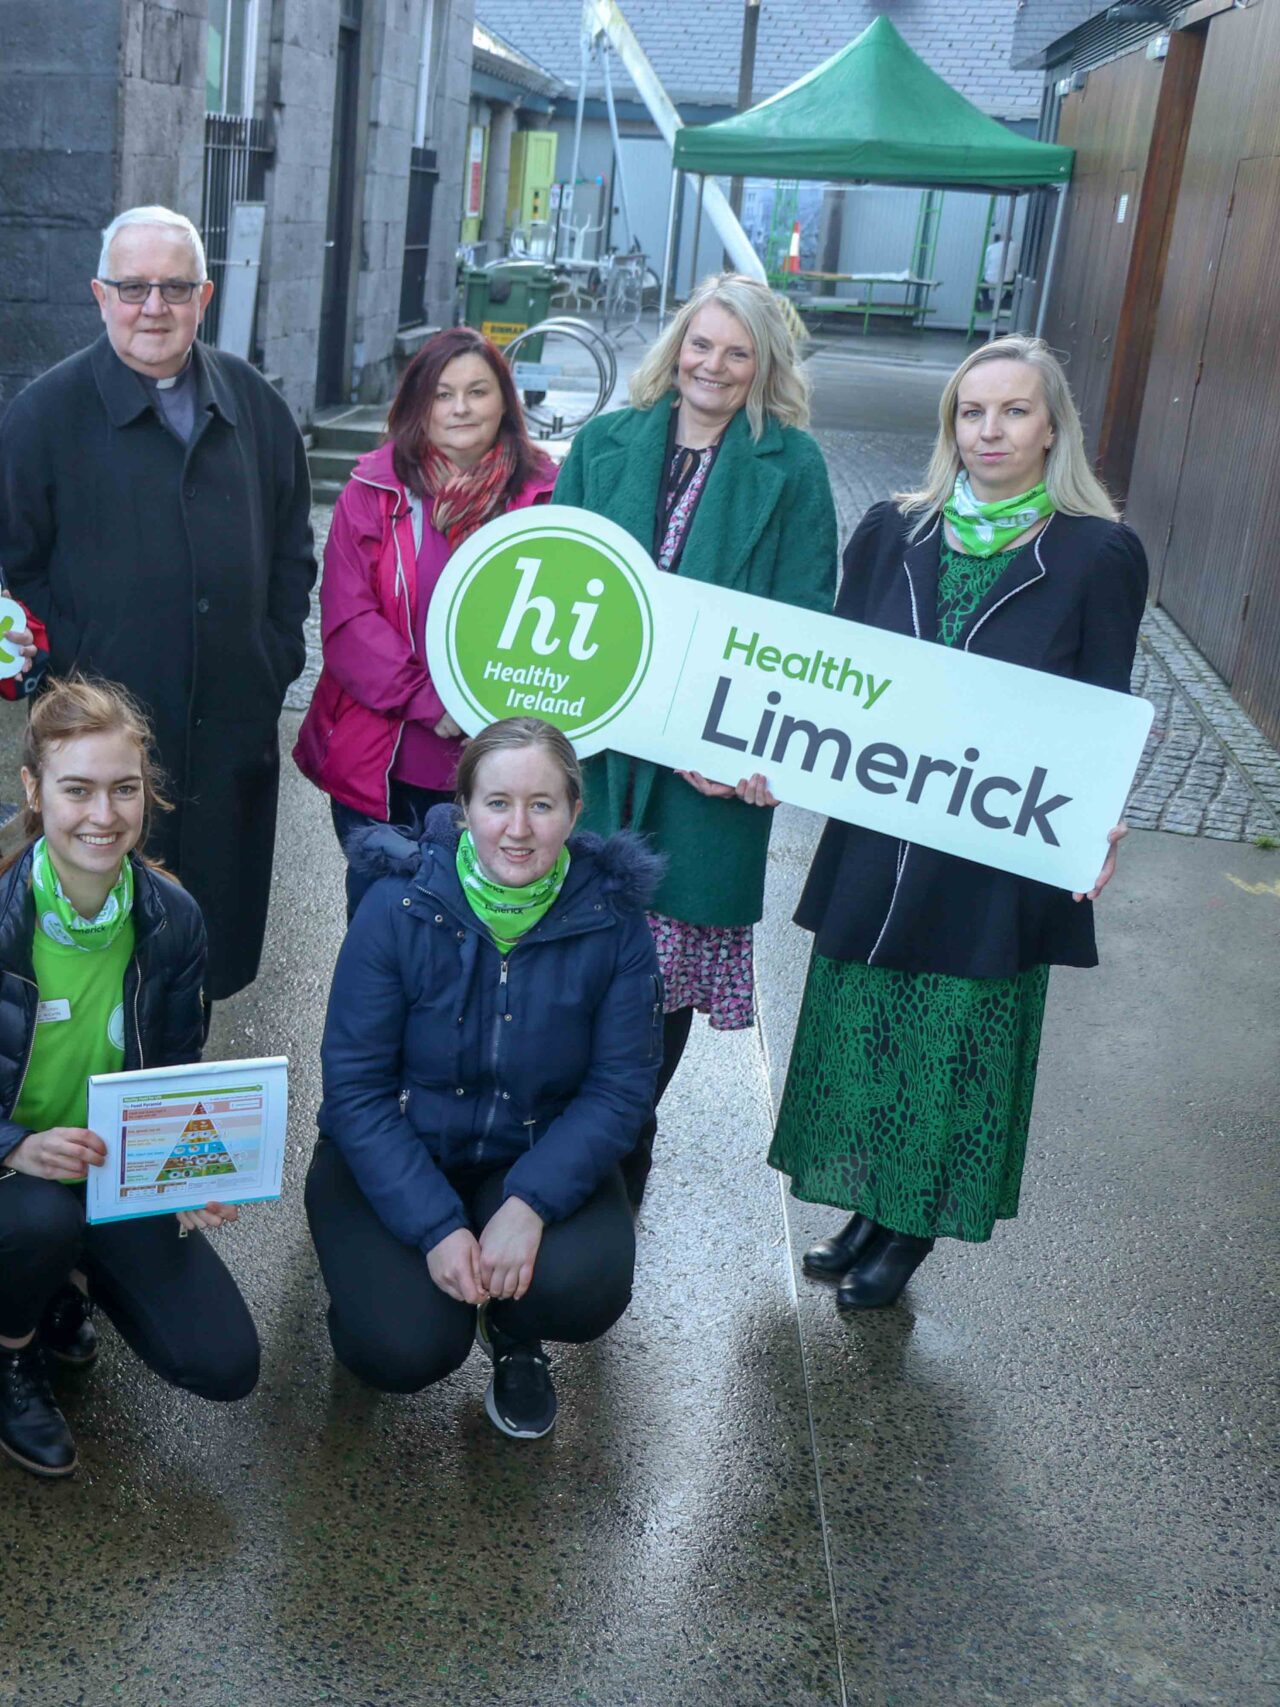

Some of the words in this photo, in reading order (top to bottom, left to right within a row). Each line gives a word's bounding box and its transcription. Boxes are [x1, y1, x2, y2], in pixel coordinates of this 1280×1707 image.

[497, 556, 605, 662] hi
[482, 660, 570, 695] Healthy
[505, 688, 586, 718] Ireland
[721, 626, 892, 710] Healthy
[701, 676, 1073, 848] Limerick
